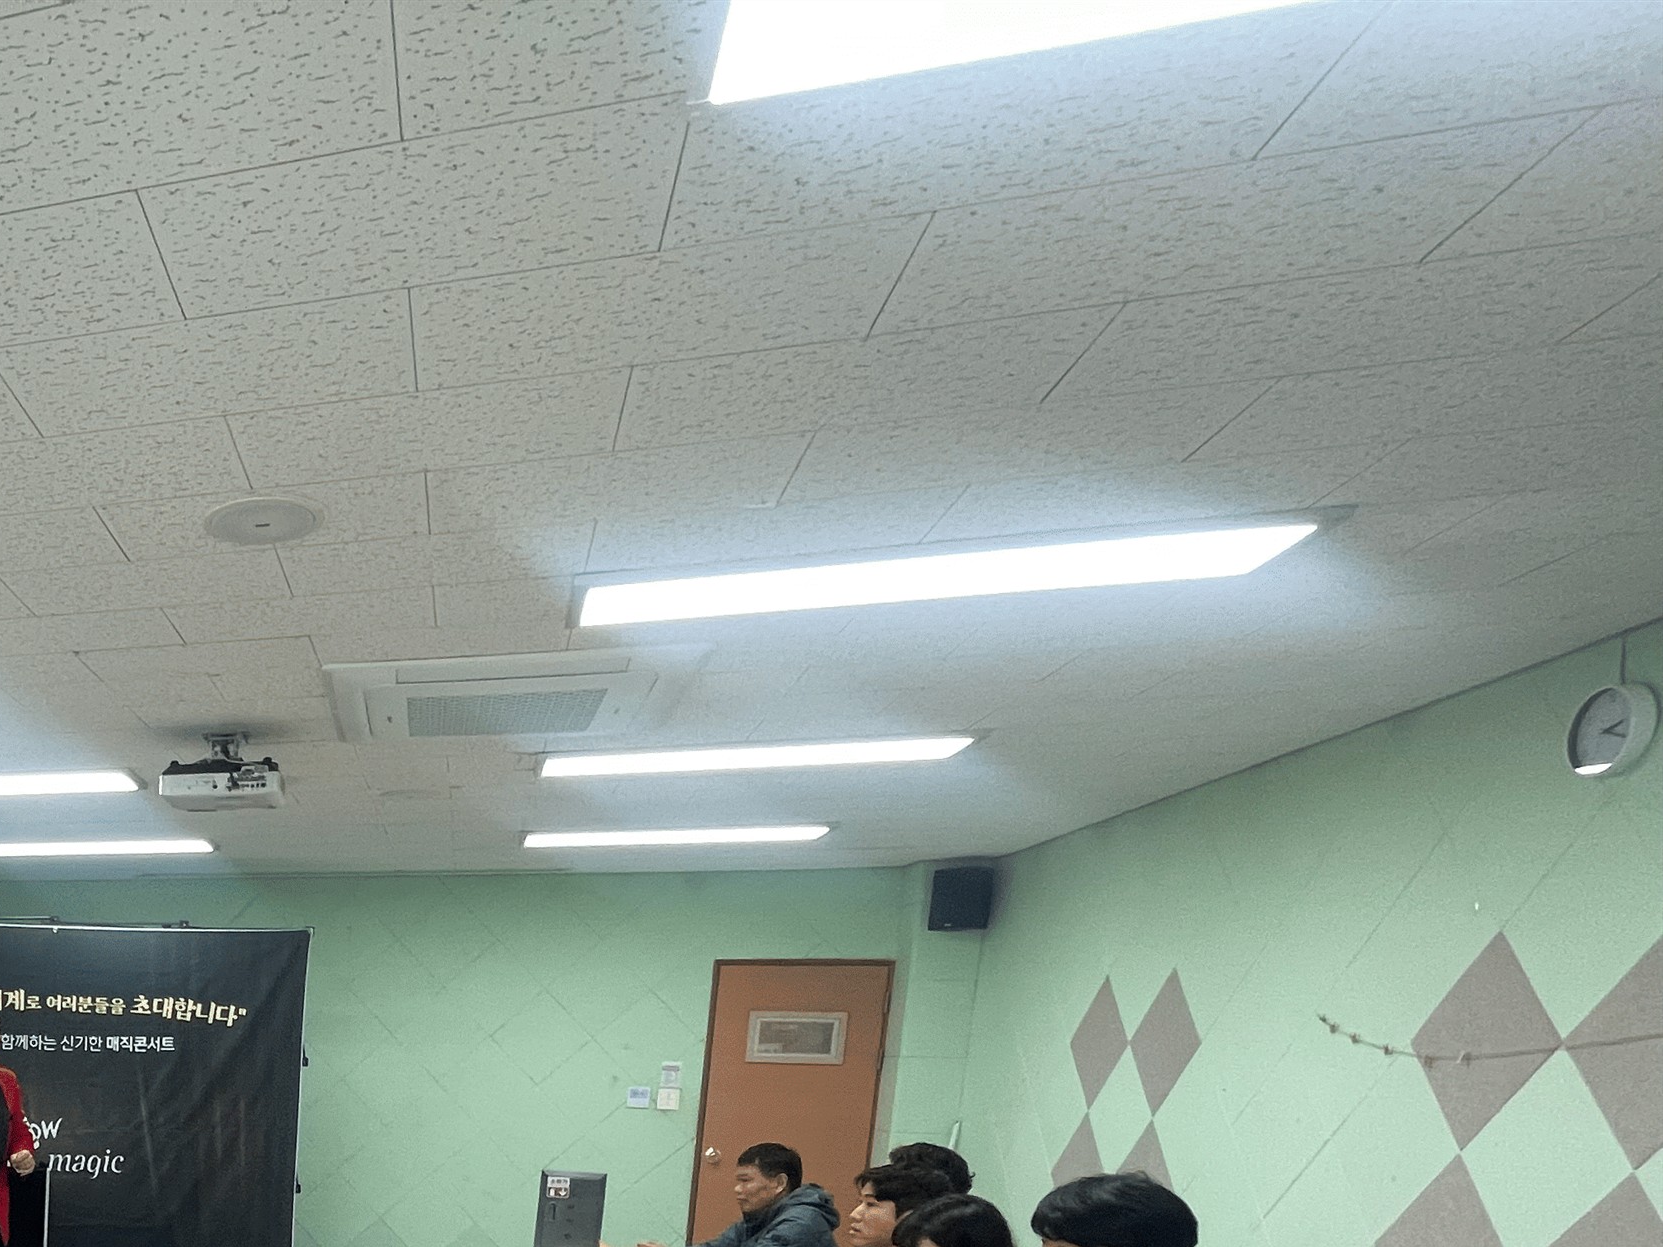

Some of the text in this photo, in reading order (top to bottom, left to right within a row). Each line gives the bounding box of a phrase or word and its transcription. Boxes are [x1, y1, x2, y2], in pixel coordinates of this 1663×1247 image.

[46, 994, 126, 1015] 여러분들을
[130, 995, 247, 1027] 초대합니다"
[0, 1034, 57, 1051] 함께하는
[60, 1035, 102, 1051] 신기한
[106, 1036, 175, 1052] 매직콘서트
[48, 1149, 125, 1180] magic
